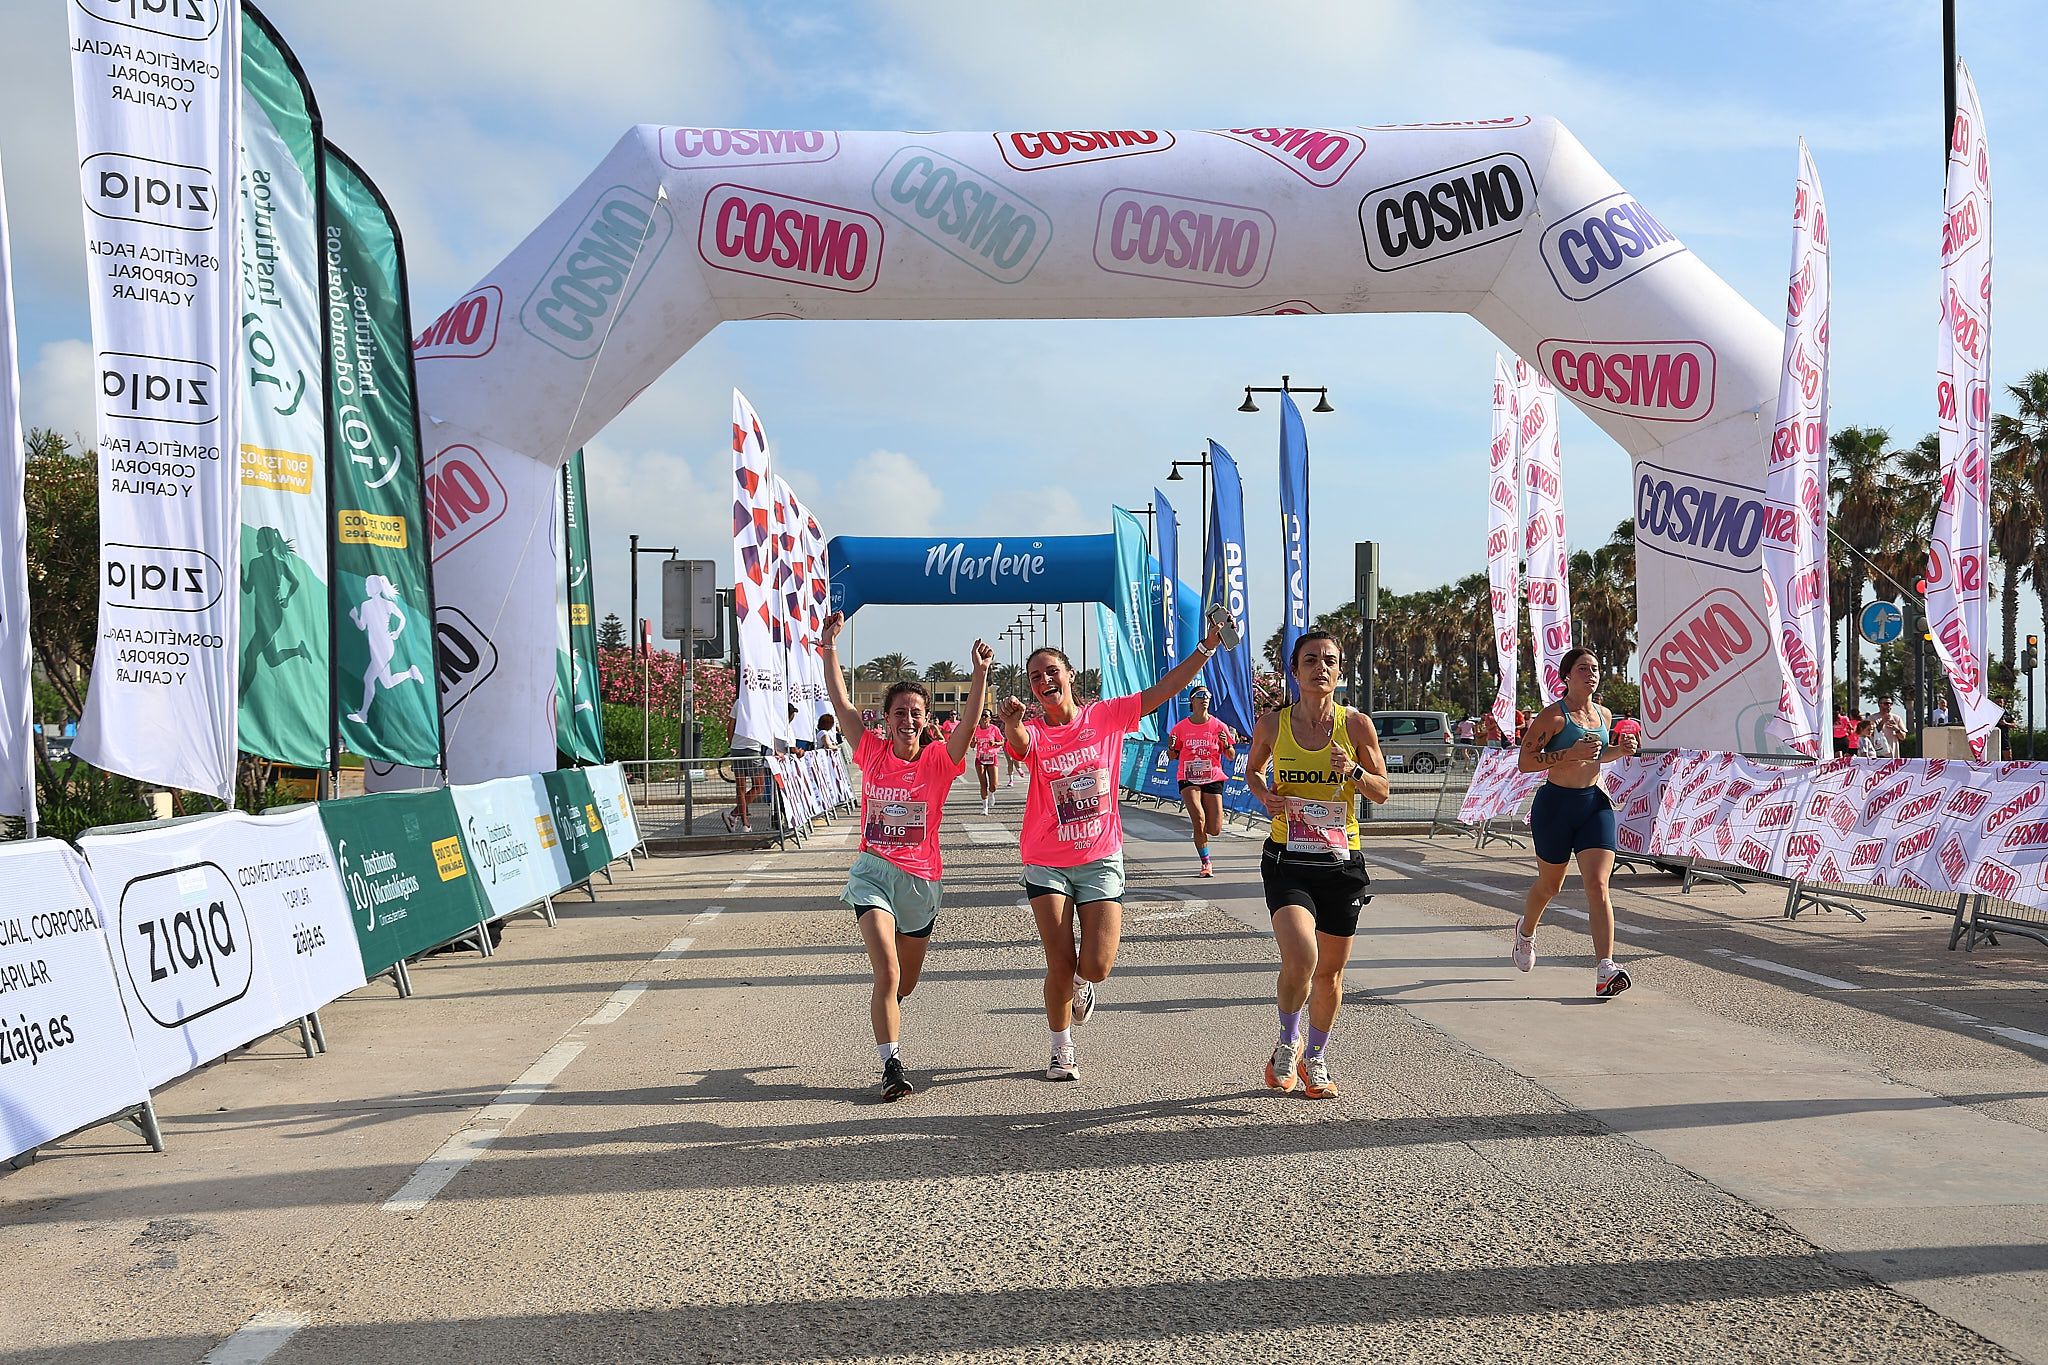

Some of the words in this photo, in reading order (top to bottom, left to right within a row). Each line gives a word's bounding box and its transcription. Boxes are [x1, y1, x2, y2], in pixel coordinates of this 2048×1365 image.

[674, 128, 824, 158] COSMO
[890, 155, 1037, 270] COSMO
[1375, 164, 1524, 258] COSMO
[716, 197, 868, 282] COSMO
[1110, 200, 1260, 278] COSMO
[1558, 201, 1677, 285] COSM
[536, 200, 657, 341] COSMO
[1551, 349, 1701, 410] COSMO
[1637, 474, 1765, 558] COSMO
[924, 541, 1045, 595] Marlene
[1640, 603, 1753, 723] COSMO
[1042, 745, 1100, 773] CARRERA
[1075, 796, 1099, 810] 016
[1759, 804, 1794, 828] COSMO
[1867, 780, 1908, 820] COSMO
[1897, 791, 1942, 823] COSMO
[1947, 789, 1988, 817] COSMO
[1986, 785, 2041, 833] COSMO
[883, 825, 906, 836] 016
[1895, 826, 1936, 862] COSMO
[360, 850, 397, 877] Institutos
[1739, 839, 1770, 872] COSMO
[1850, 842, 1883, 867] COSMO
[369, 872, 420, 906] Odontológicos
[1975, 860, 2016, 900] COSMO
[31, 907, 102, 940] CORPORA
[292, 921, 326, 957] ziaja.es
[138, 900, 236, 988] ziaja
